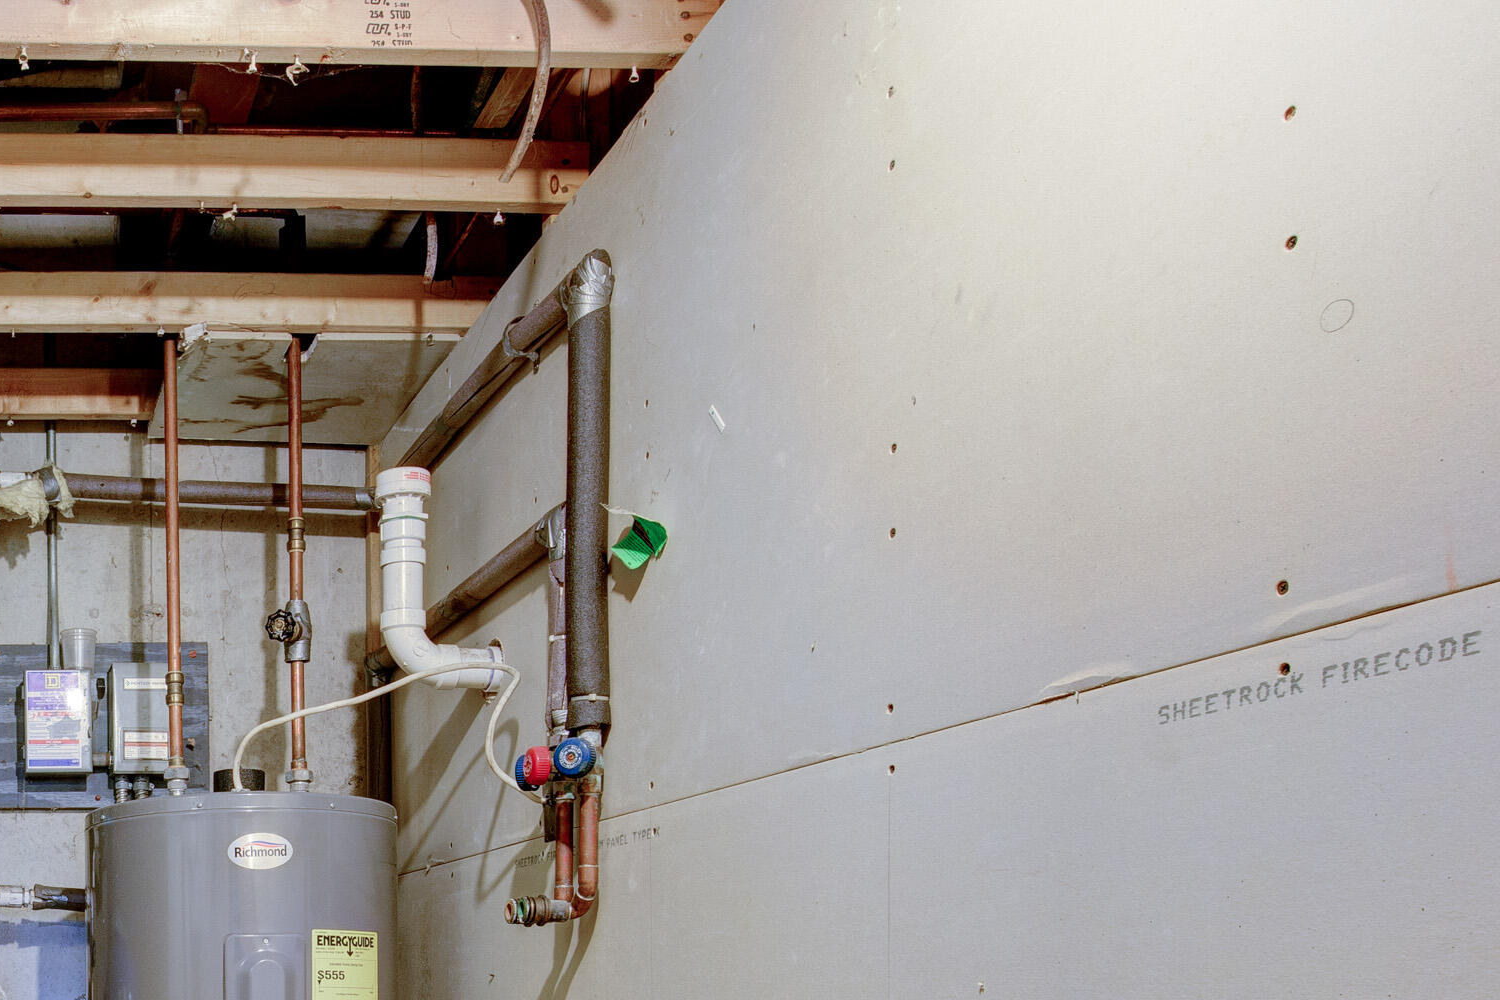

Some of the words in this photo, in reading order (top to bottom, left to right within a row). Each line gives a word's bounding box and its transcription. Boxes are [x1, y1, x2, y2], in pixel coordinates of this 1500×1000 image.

[390, 9, 411, 19] STUD
[1158, 673, 1304, 725] SHEETROCK
[1321, 630, 1482, 688] FIRECODE
[633, 828, 652, 843] TYPE
[234, 844, 287, 858] Richmond
[317, 935, 374, 949] ENERGYGUIDE
[317, 970, 346, 981] $555
